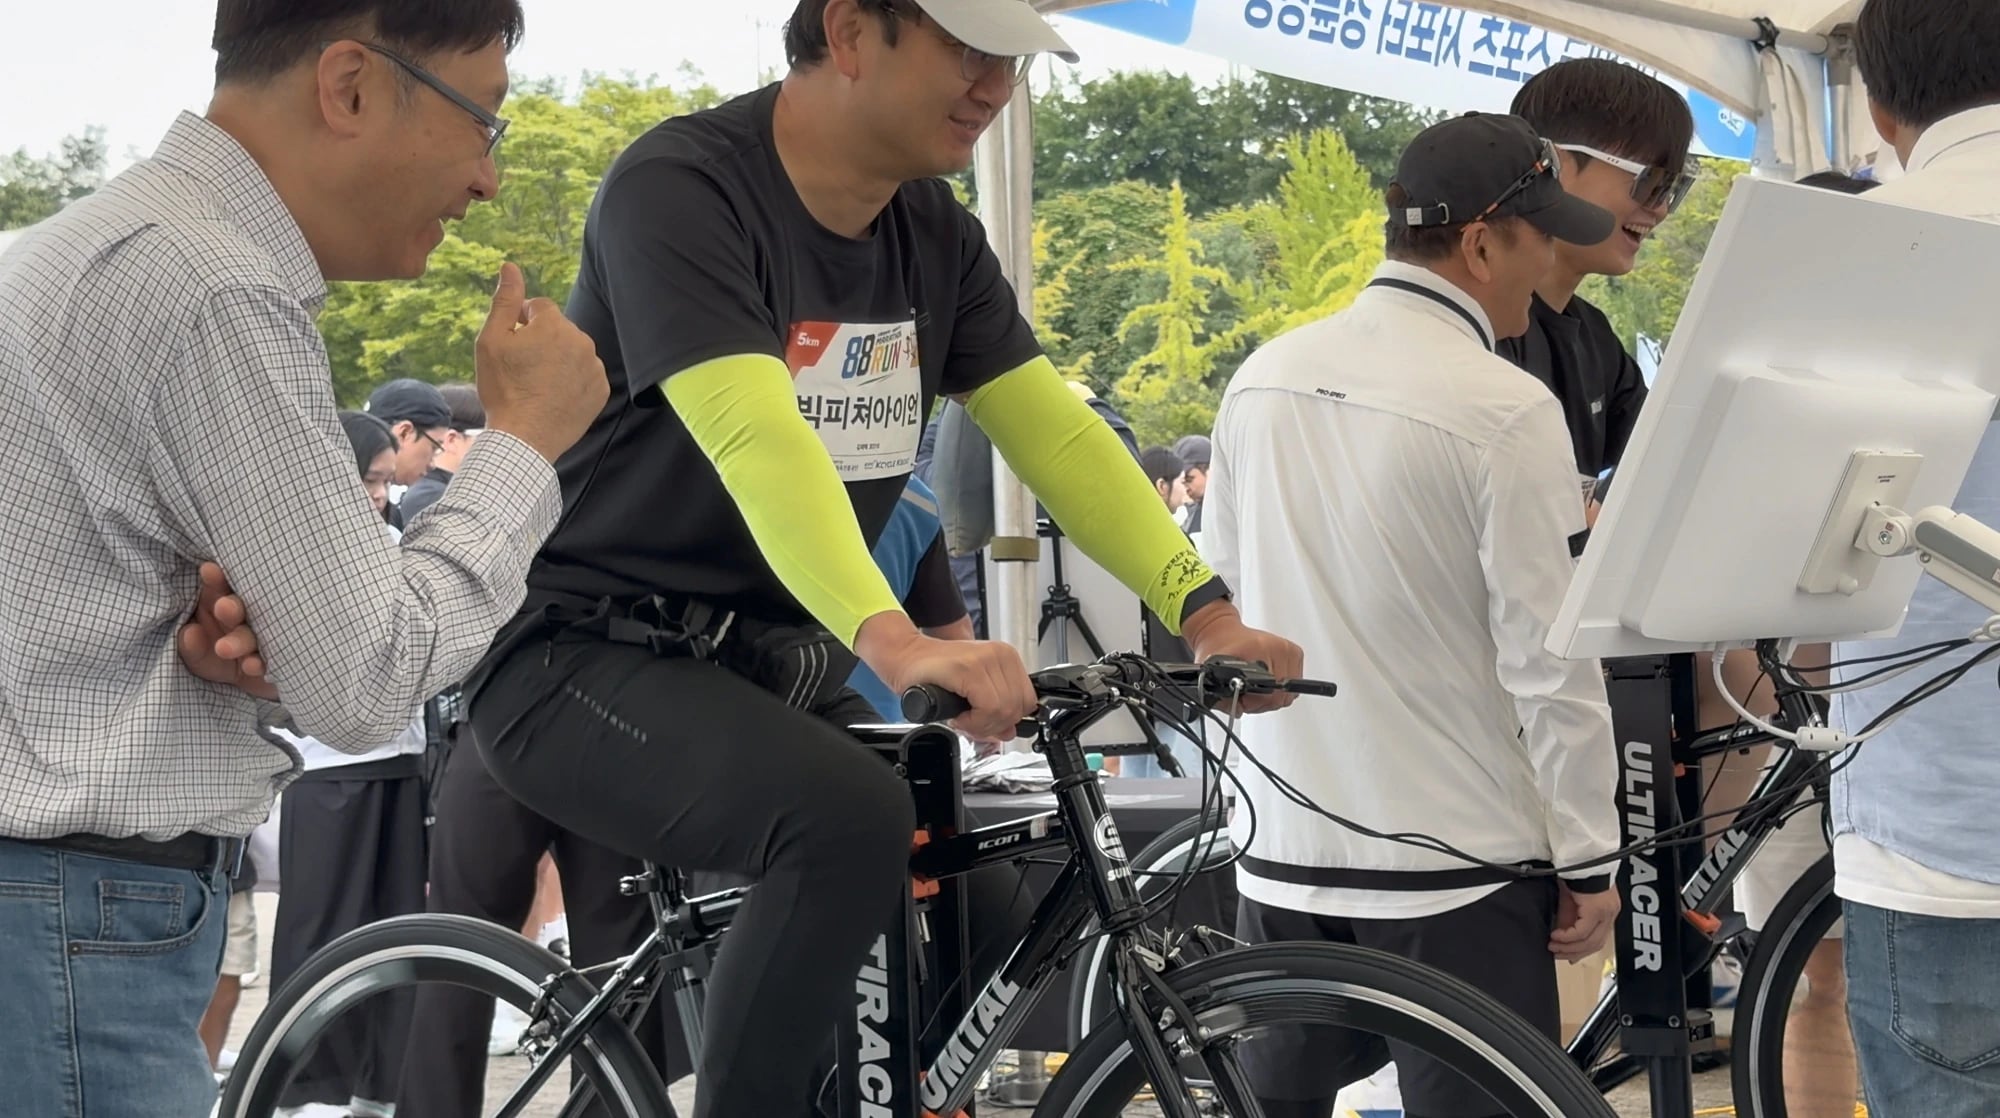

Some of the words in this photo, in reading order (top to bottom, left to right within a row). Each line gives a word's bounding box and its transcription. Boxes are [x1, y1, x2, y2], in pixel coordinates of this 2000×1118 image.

[797, 332, 820, 347] 5km
[870, 340, 902, 376] RUN
[797, 392, 919, 430] 빅피쳐아이언
[1624, 741, 1662, 972] ULTIRACER
